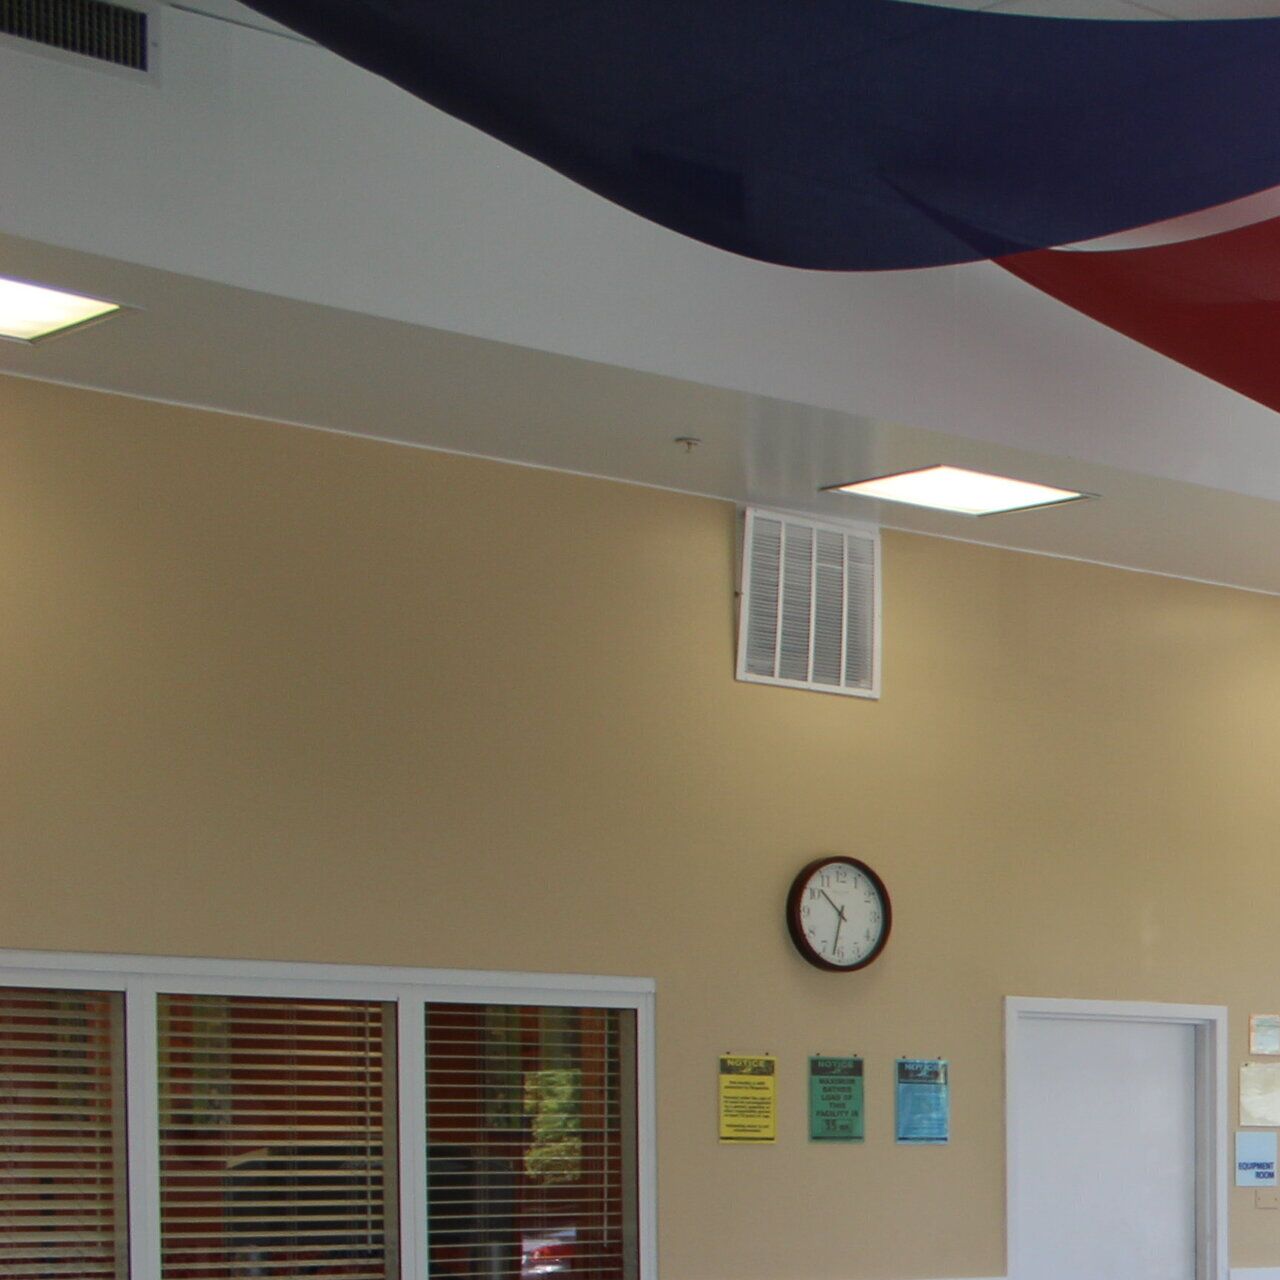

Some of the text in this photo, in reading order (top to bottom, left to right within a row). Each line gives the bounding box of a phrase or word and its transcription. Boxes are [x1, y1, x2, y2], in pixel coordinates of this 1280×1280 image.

[818, 1060, 853, 1068] NOTICE
[1238, 1162, 1274, 1170] EQUIPMENT
[1255, 1171, 1275, 1179] ROOM
